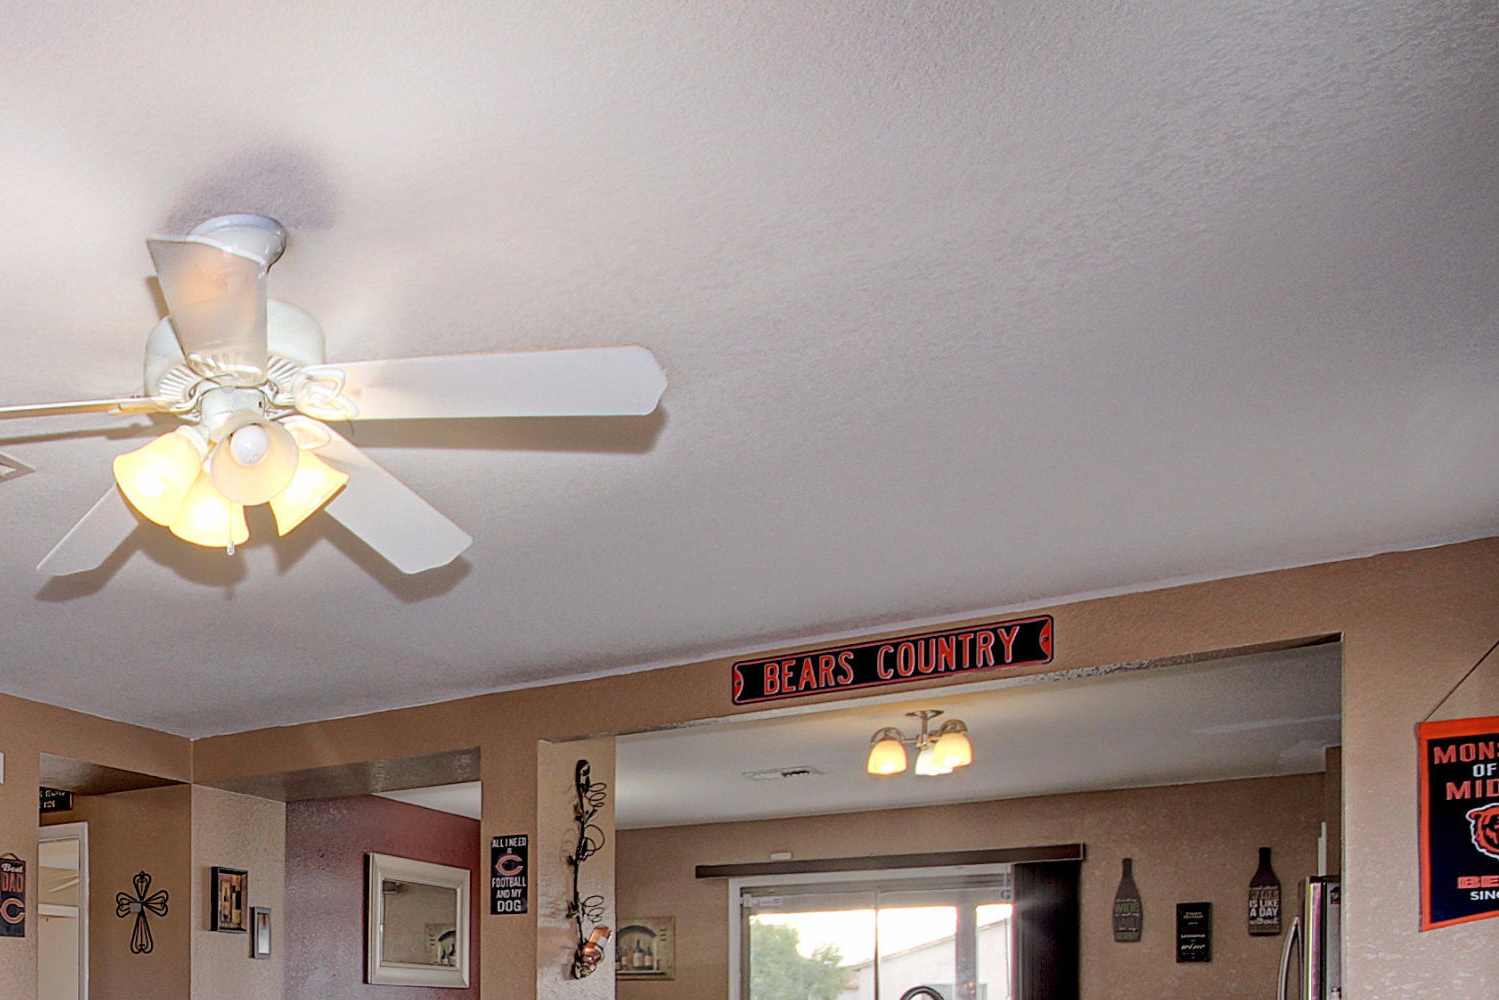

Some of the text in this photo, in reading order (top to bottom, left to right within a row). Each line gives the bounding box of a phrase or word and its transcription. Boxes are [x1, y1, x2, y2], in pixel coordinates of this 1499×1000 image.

[763, 625, 1021, 696] BEARS COUNTRY
[1433, 741, 1499, 764] MON
[1473, 763, 1497, 777] OF
[509, 837, 527, 847] NEED
[1, 872, 24, 893] DAD
[491, 876, 527, 888] FOOTBALL
[495, 888, 523, 899] AND MY
[497, 900, 522, 912] DOG
[1259, 908, 1278, 917] DAY
